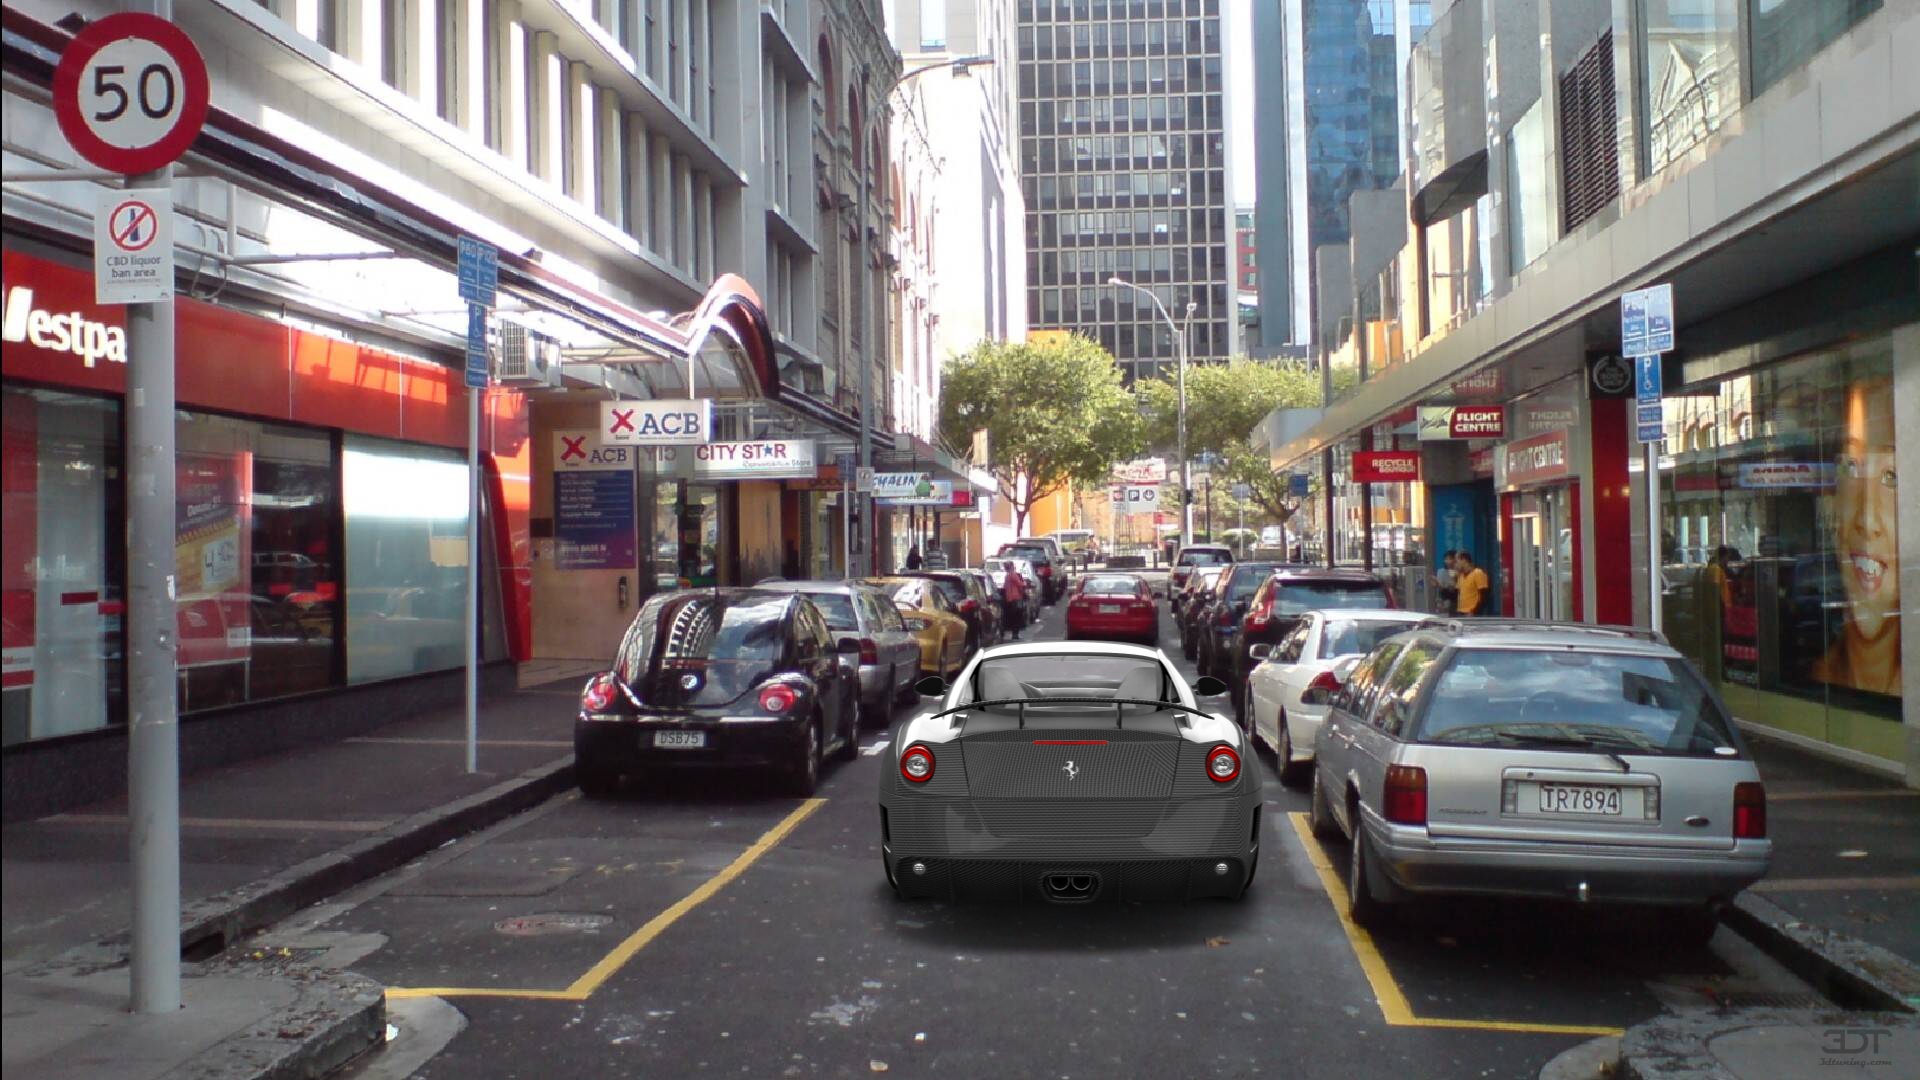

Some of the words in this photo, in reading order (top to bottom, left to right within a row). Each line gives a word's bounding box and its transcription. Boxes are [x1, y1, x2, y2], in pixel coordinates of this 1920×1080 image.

[94, 63, 175, 121] 50
[106, 256, 129, 266] CBD
[130, 255, 161, 267] liquor
[111, 269, 131, 278] ban
[133, 269, 156, 277] area
[638, 412, 700, 435] ACB
[1456, 412, 1501, 422] FLIGHT
[1455, 423, 1502, 433] CENTRE
[589, 447, 628, 464] ACB
[696, 444, 737, 461] CITY
[1543, 788, 1618, 811] TR7894
